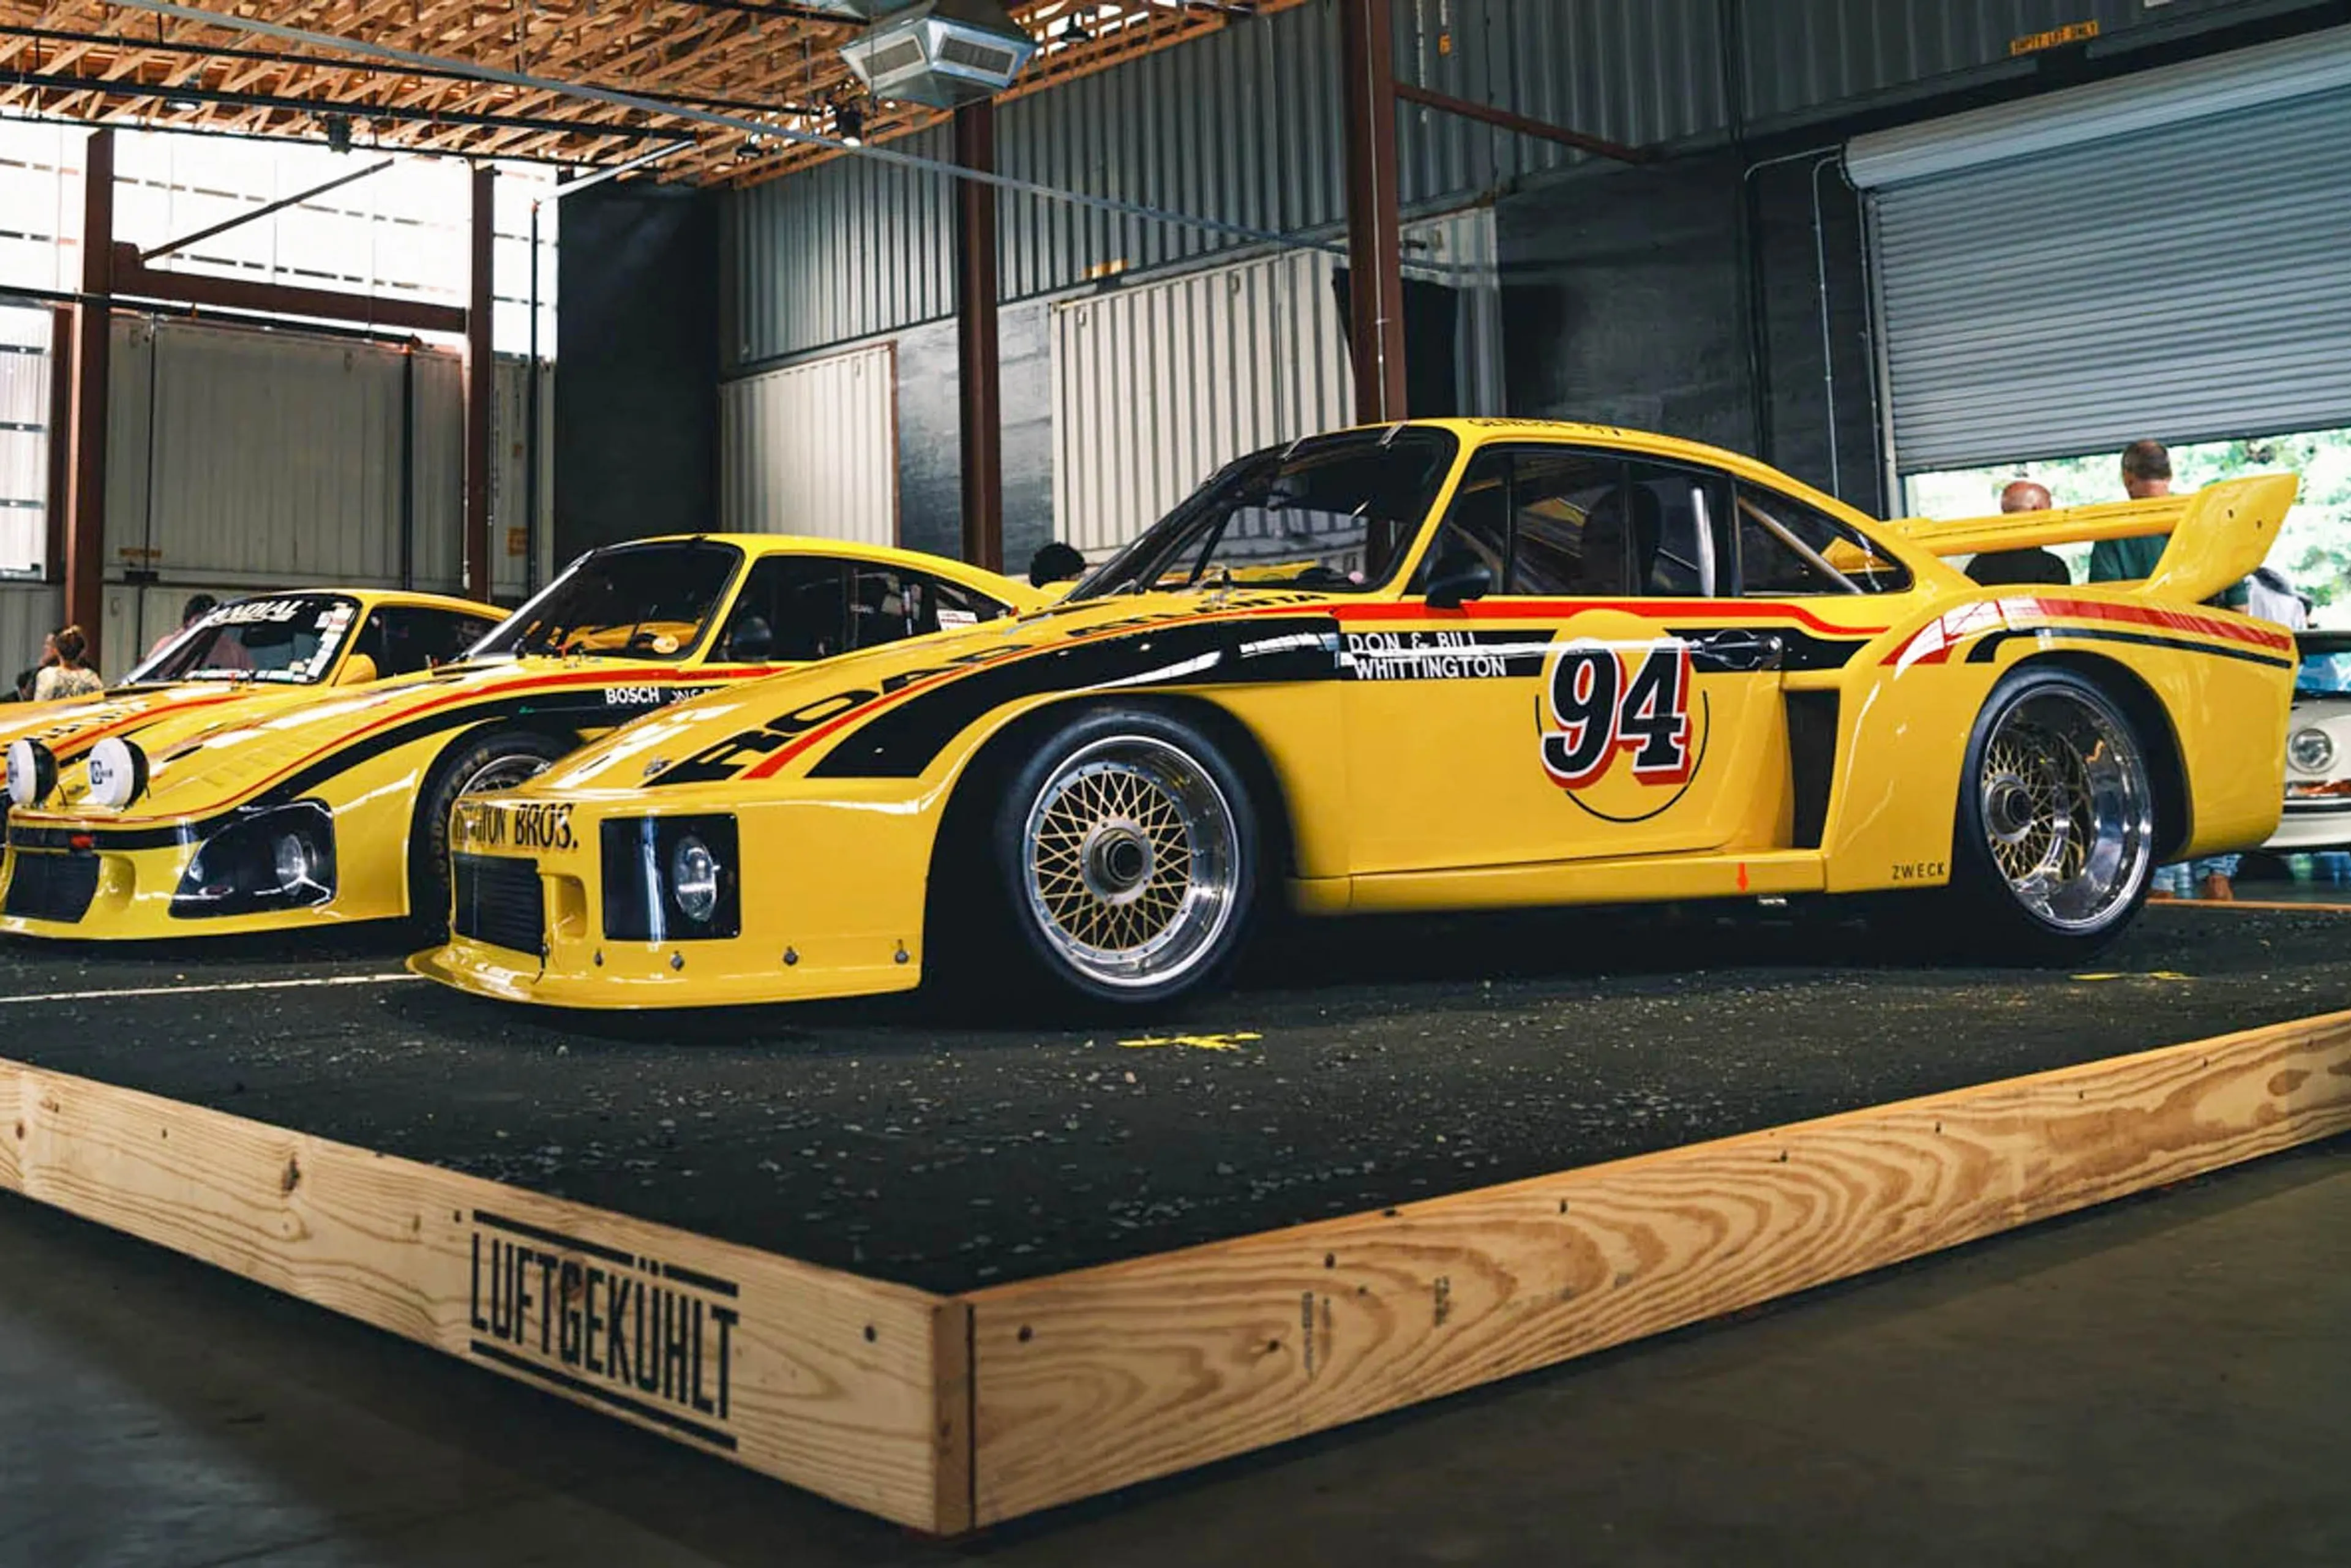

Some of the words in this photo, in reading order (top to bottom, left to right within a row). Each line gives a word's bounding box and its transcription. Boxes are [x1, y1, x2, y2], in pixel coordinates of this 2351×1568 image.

[1348, 633, 1401, 653] DON
[1411, 632, 1431, 650] &
[1436, 631, 1478, 648] BILL
[1354, 656, 1507, 680] WHITTINGTON
[605, 686, 660, 703] BOSCH
[1540, 638, 1692, 790] 94
[515, 803, 579, 849] BROS.
[1892, 861, 1944, 880] ZWECK
[471, 1232, 740, 1419] LUFTGEKÜHLT
